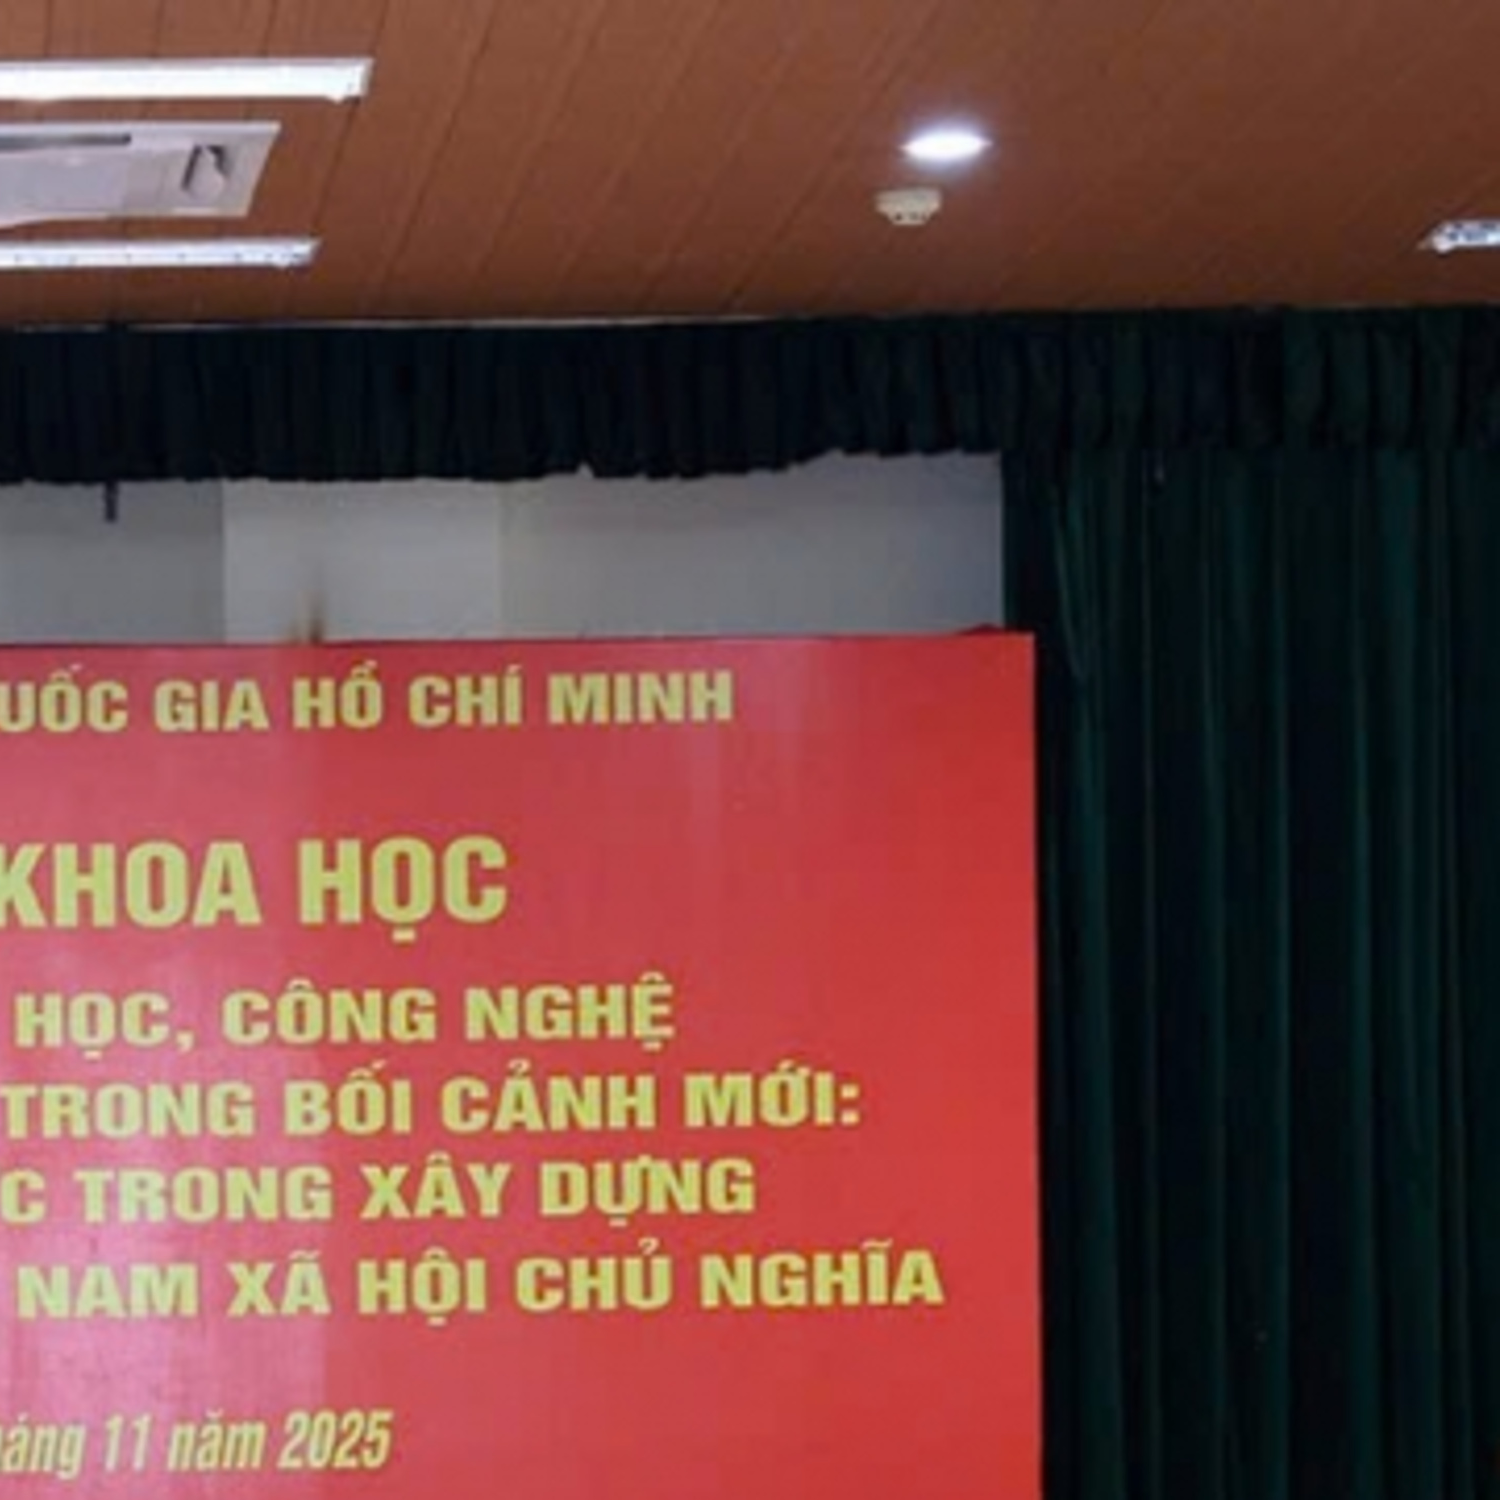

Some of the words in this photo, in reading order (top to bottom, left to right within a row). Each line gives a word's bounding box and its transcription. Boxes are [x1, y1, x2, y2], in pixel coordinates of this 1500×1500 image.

[154, 680, 269, 731] GIA
[292, 660, 384, 729] HỒ
[407, 665, 523, 728] CHÍ
[548, 670, 734, 724] MINH
[298, 835, 509, 943] HỌC
[14, 992, 195, 1060] HỌC,
[221, 979, 438, 1044] CÔNG
[465, 972, 675, 1052] NGHỆ
[0, 1081, 255, 1140] TRONG
[284, 1059, 414, 1137] BỐI
[440, 1062, 657, 1135] CẢNH
[683, 1059, 863, 1129] MỚI:
[75, 1165, 335, 1223] TRONG
[359, 1152, 513, 1220] XÂY
[539, 1153, 757, 1227] DỰNG
[17, 1261, 199, 1319] NAM
[226, 1251, 331, 1316] XÃ
[357, 1251, 488, 1327] HỘI
[514, 1237, 675, 1313] CHỦ
[698, 1237, 945, 1308] NGHĨA
[103, 1413, 152, 1472] 11
[166, 1408, 268, 1472] năm
[277, 1408, 394, 1470] 2025
